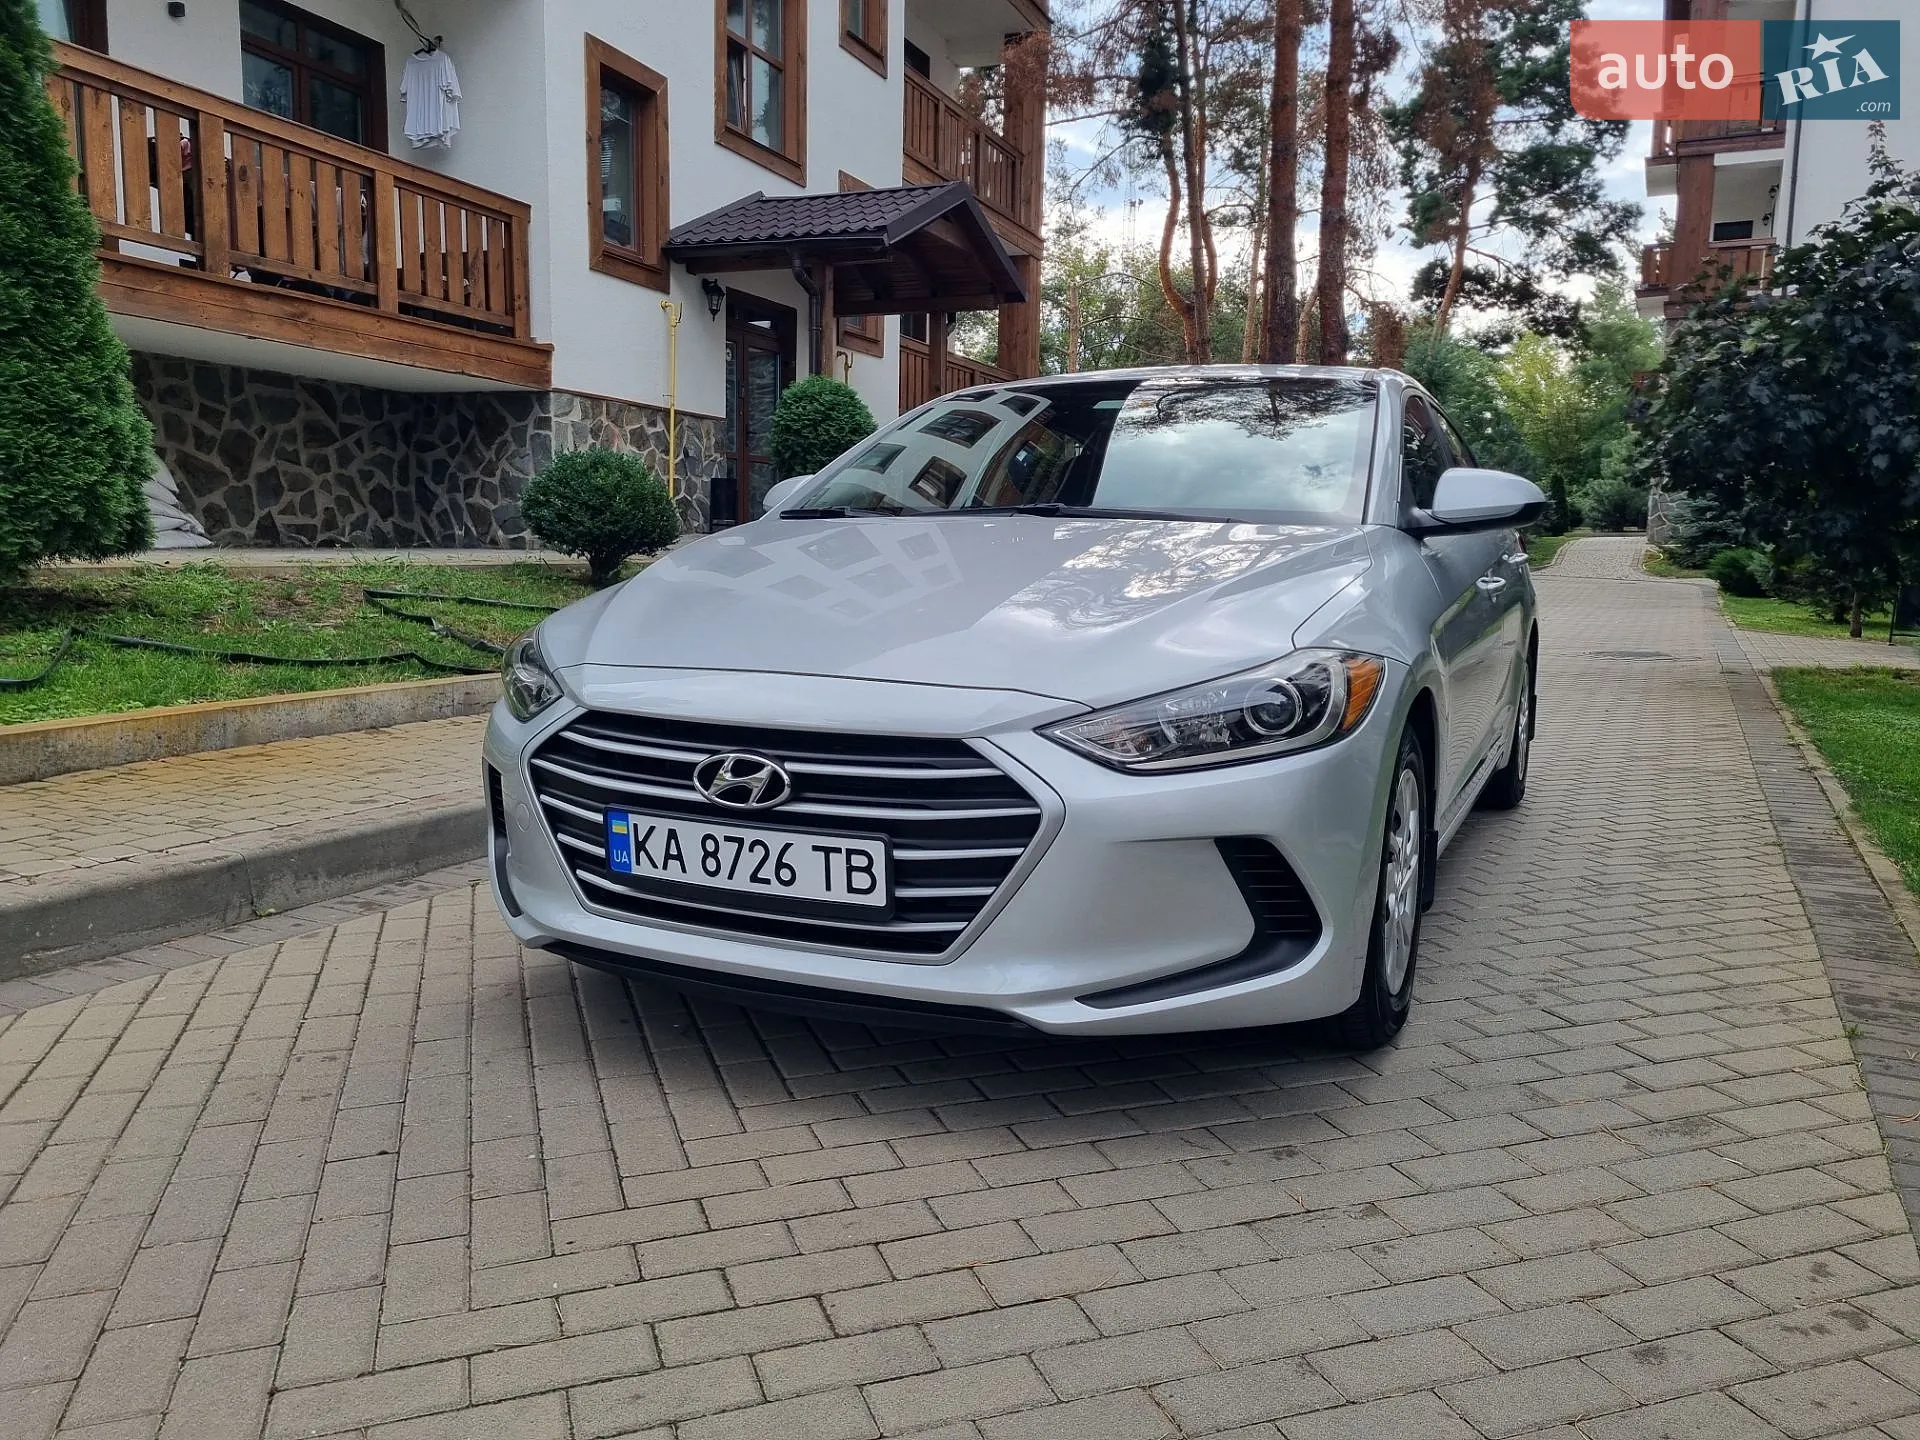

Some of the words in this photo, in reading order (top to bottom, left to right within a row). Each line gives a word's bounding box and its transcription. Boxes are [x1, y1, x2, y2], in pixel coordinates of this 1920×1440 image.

[613, 849, 630, 864] UA
[632, 822, 687, 874] KA
[700, 833, 797, 887] 8726
[811, 844, 877, 895] TB
